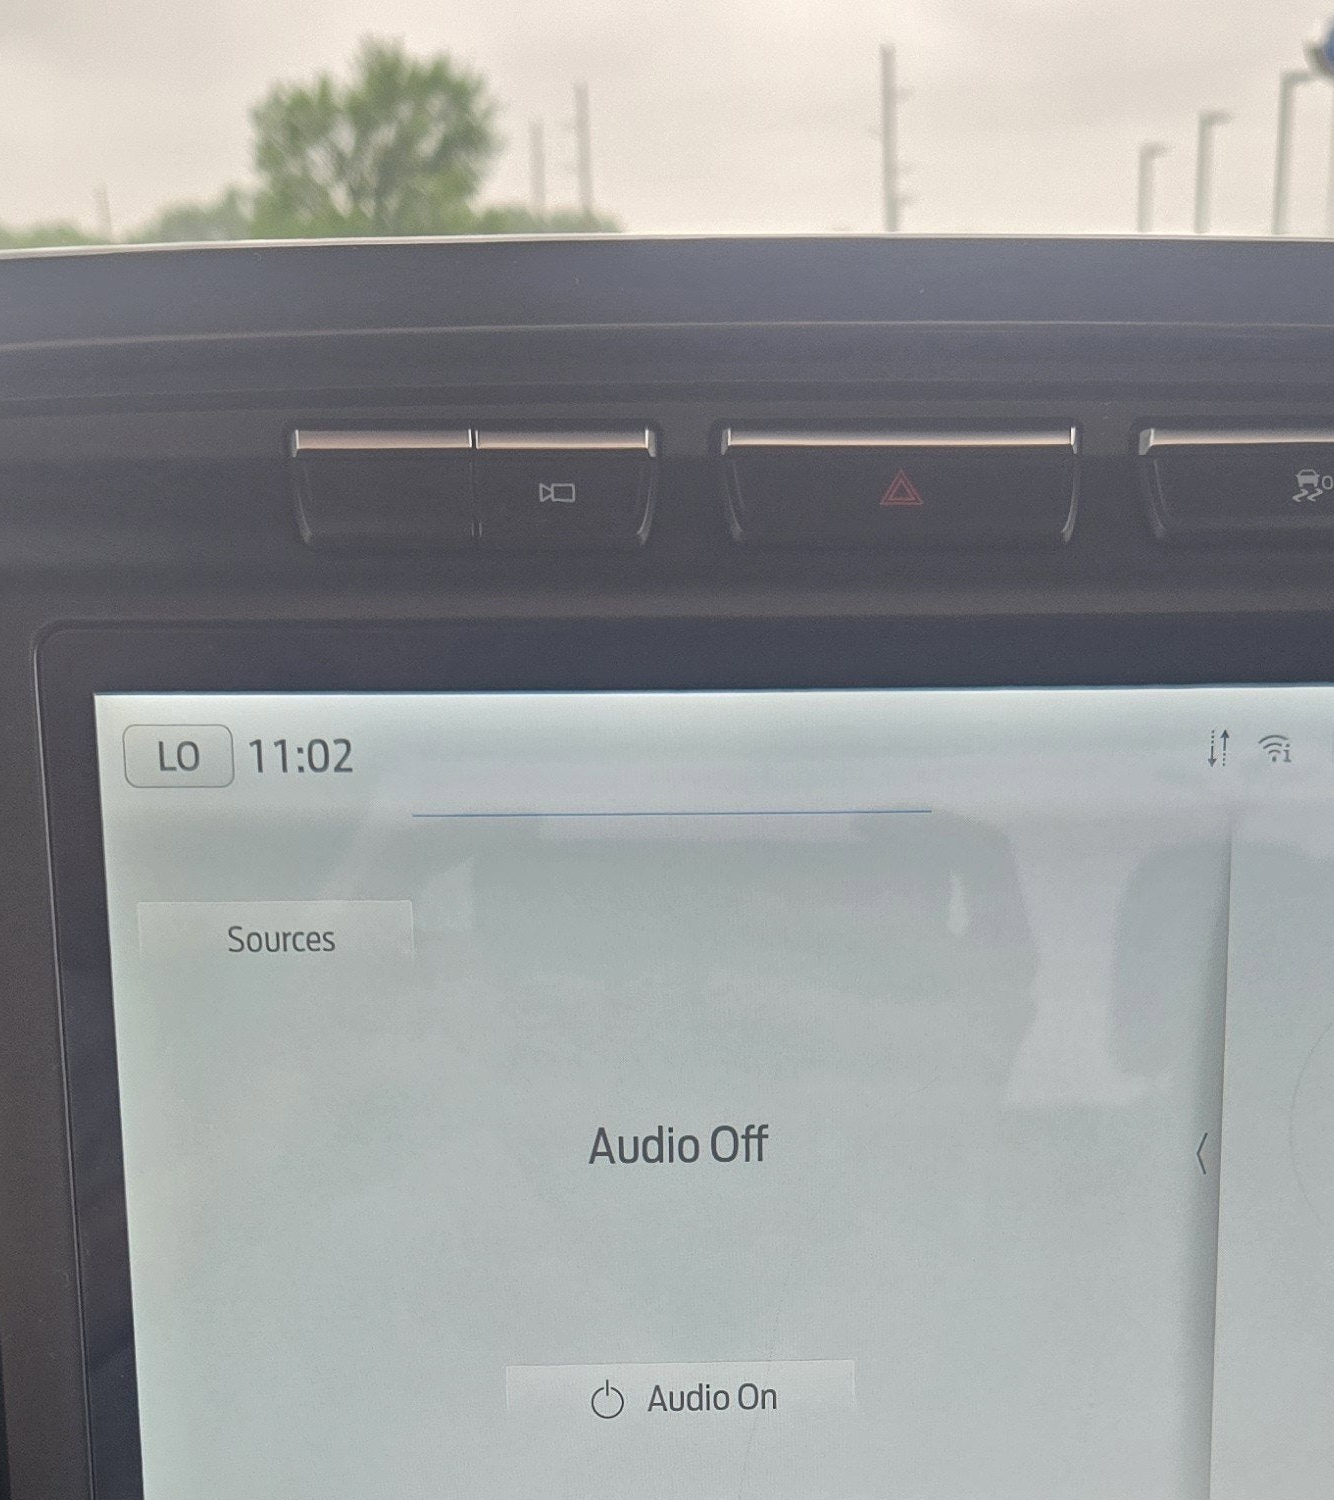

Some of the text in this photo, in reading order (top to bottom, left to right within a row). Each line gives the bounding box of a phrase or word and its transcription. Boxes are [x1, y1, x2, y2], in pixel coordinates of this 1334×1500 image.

[158, 741, 200, 773] LO
[249, 739, 353, 774] 11:02
[228, 926, 336, 954] Sources
[588, 1124, 769, 1166] Audio Off
[647, 1383, 777, 1413] Audio On
